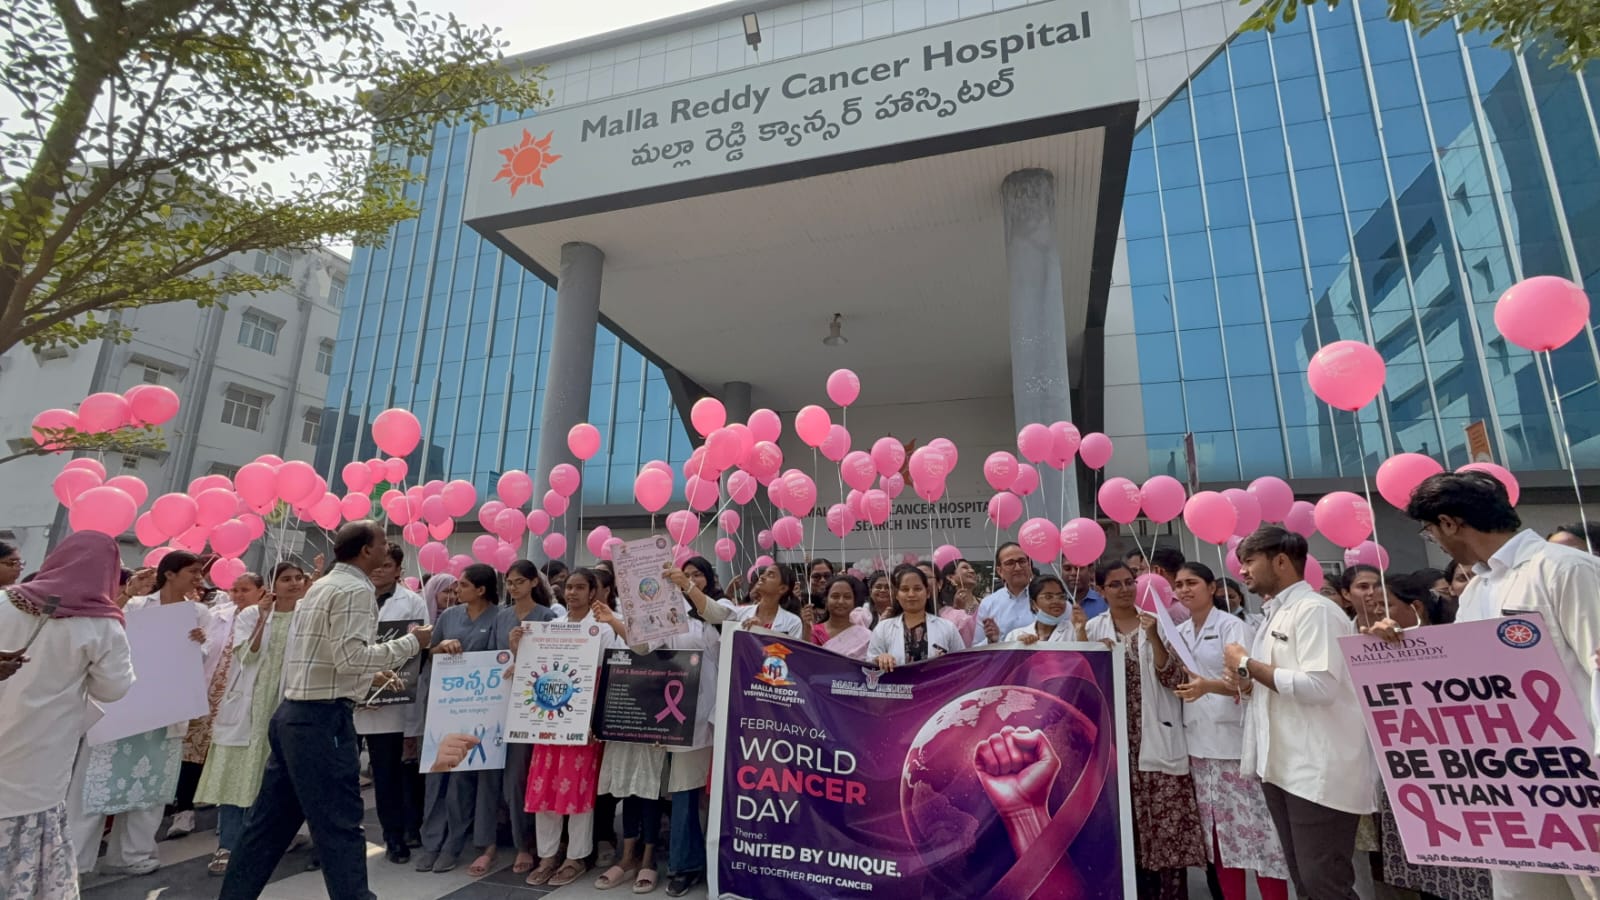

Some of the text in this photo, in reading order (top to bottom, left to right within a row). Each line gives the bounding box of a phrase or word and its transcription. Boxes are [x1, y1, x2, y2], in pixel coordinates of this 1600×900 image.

[580, 11, 1091, 142] Malla Reddy Cancer Hospital
[631, 67, 1016, 169] మల్లా రెడ్డి క్యాన్సర్ హాస్పిటల్
[889, 503, 936, 515] CANCER
[938, 501, 990, 514] HOSPITA
[906, 517, 972, 530] INSTITUTE
[1350, 646, 1444, 663] MALLA REDDY
[441, 668, 502, 695] కాన్సర్
[538, 682, 569, 695] CANCER
[750, 683, 799, 697] MALLA REDDY
[831, 680, 867, 692] MALLA
[1362, 674, 1517, 707] LET YOUR
[538, 731, 557, 740] HOPE
[566, 732, 584, 741] LOVE
[740, 718, 827, 740] FEBRUARY 04
[1372, 704, 1524, 746] FAITH
[739, 736, 857, 775] WORLD
[1386, 746, 1600, 780] BE BIGGER
[736, 765, 867, 806] CANCER
[1428, 784, 1514, 806] THAN
[736, 795, 799, 824] DAY
[733, 838, 902, 878] UNITED BY UNIQUE.
[732, 862, 873, 891] LET US TOGETHER FIGHT CANCER
